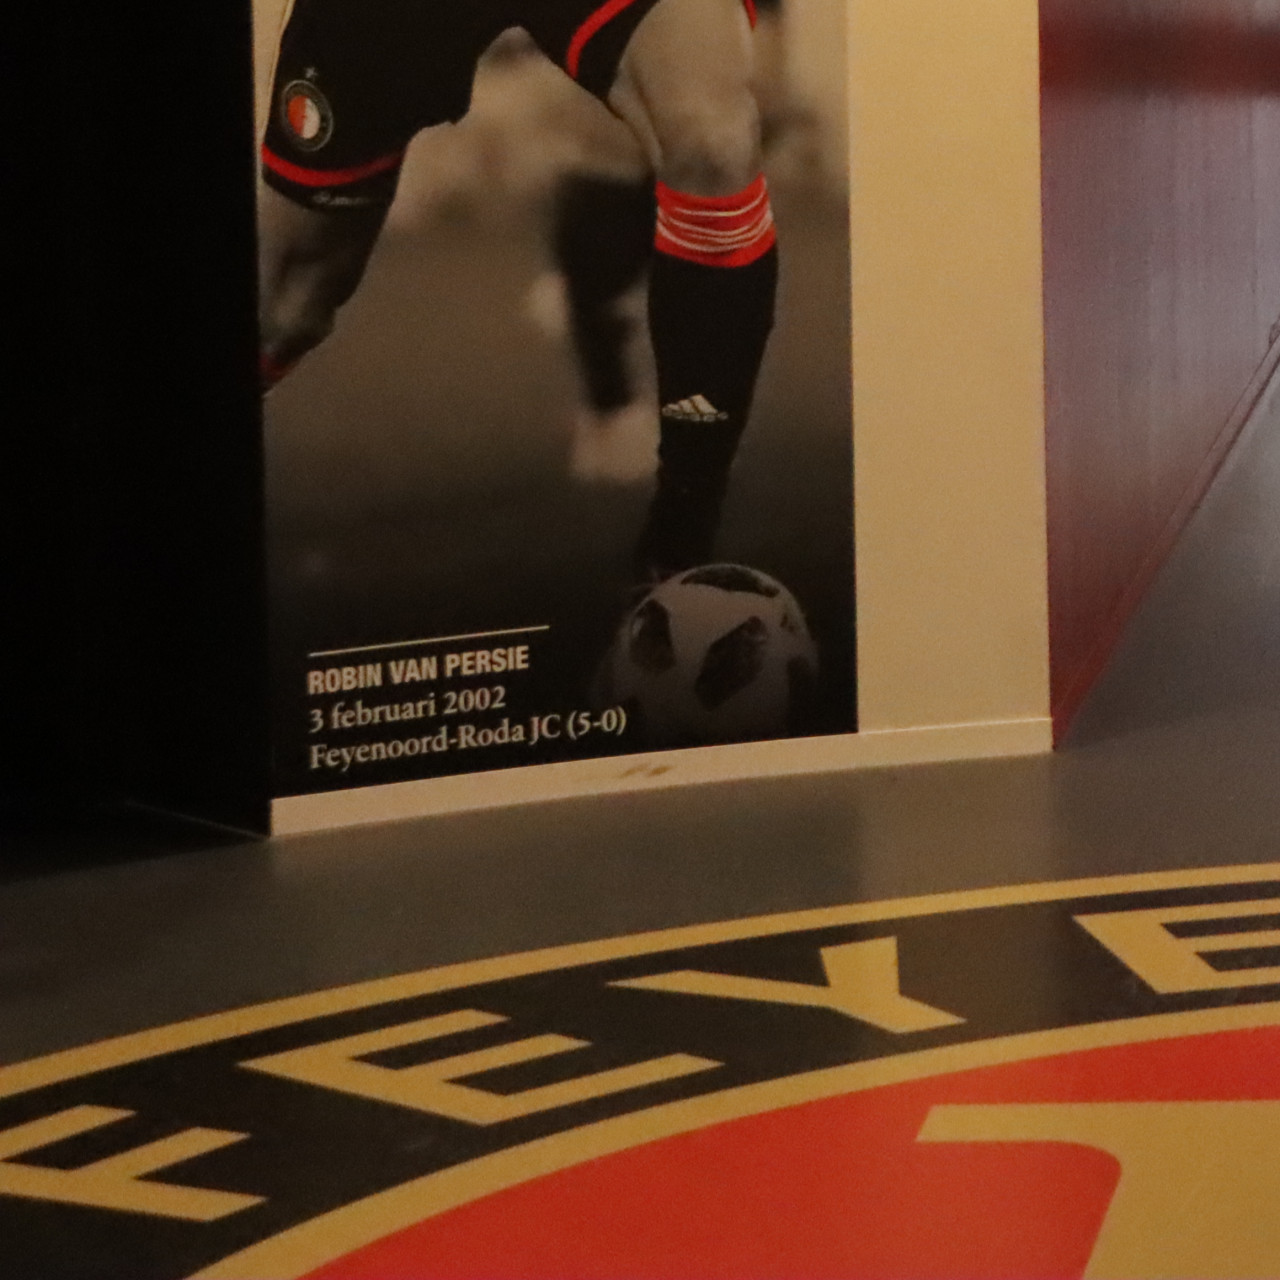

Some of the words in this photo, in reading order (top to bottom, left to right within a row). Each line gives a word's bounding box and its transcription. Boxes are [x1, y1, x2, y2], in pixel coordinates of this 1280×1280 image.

[308, 663, 382, 695] ROBIN
[389, 657, 438, 685] VAN
[445, 646, 529, 677] PERSIE
[309, 711, 325, 734] 3
[331, 693, 437, 730] februari
[443, 685, 507, 715] 2002
[310, 719, 525, 771] Feyenoord-Roda
[528, 714, 562, 746] JC
[566, 705, 628, 740] (5-0)
